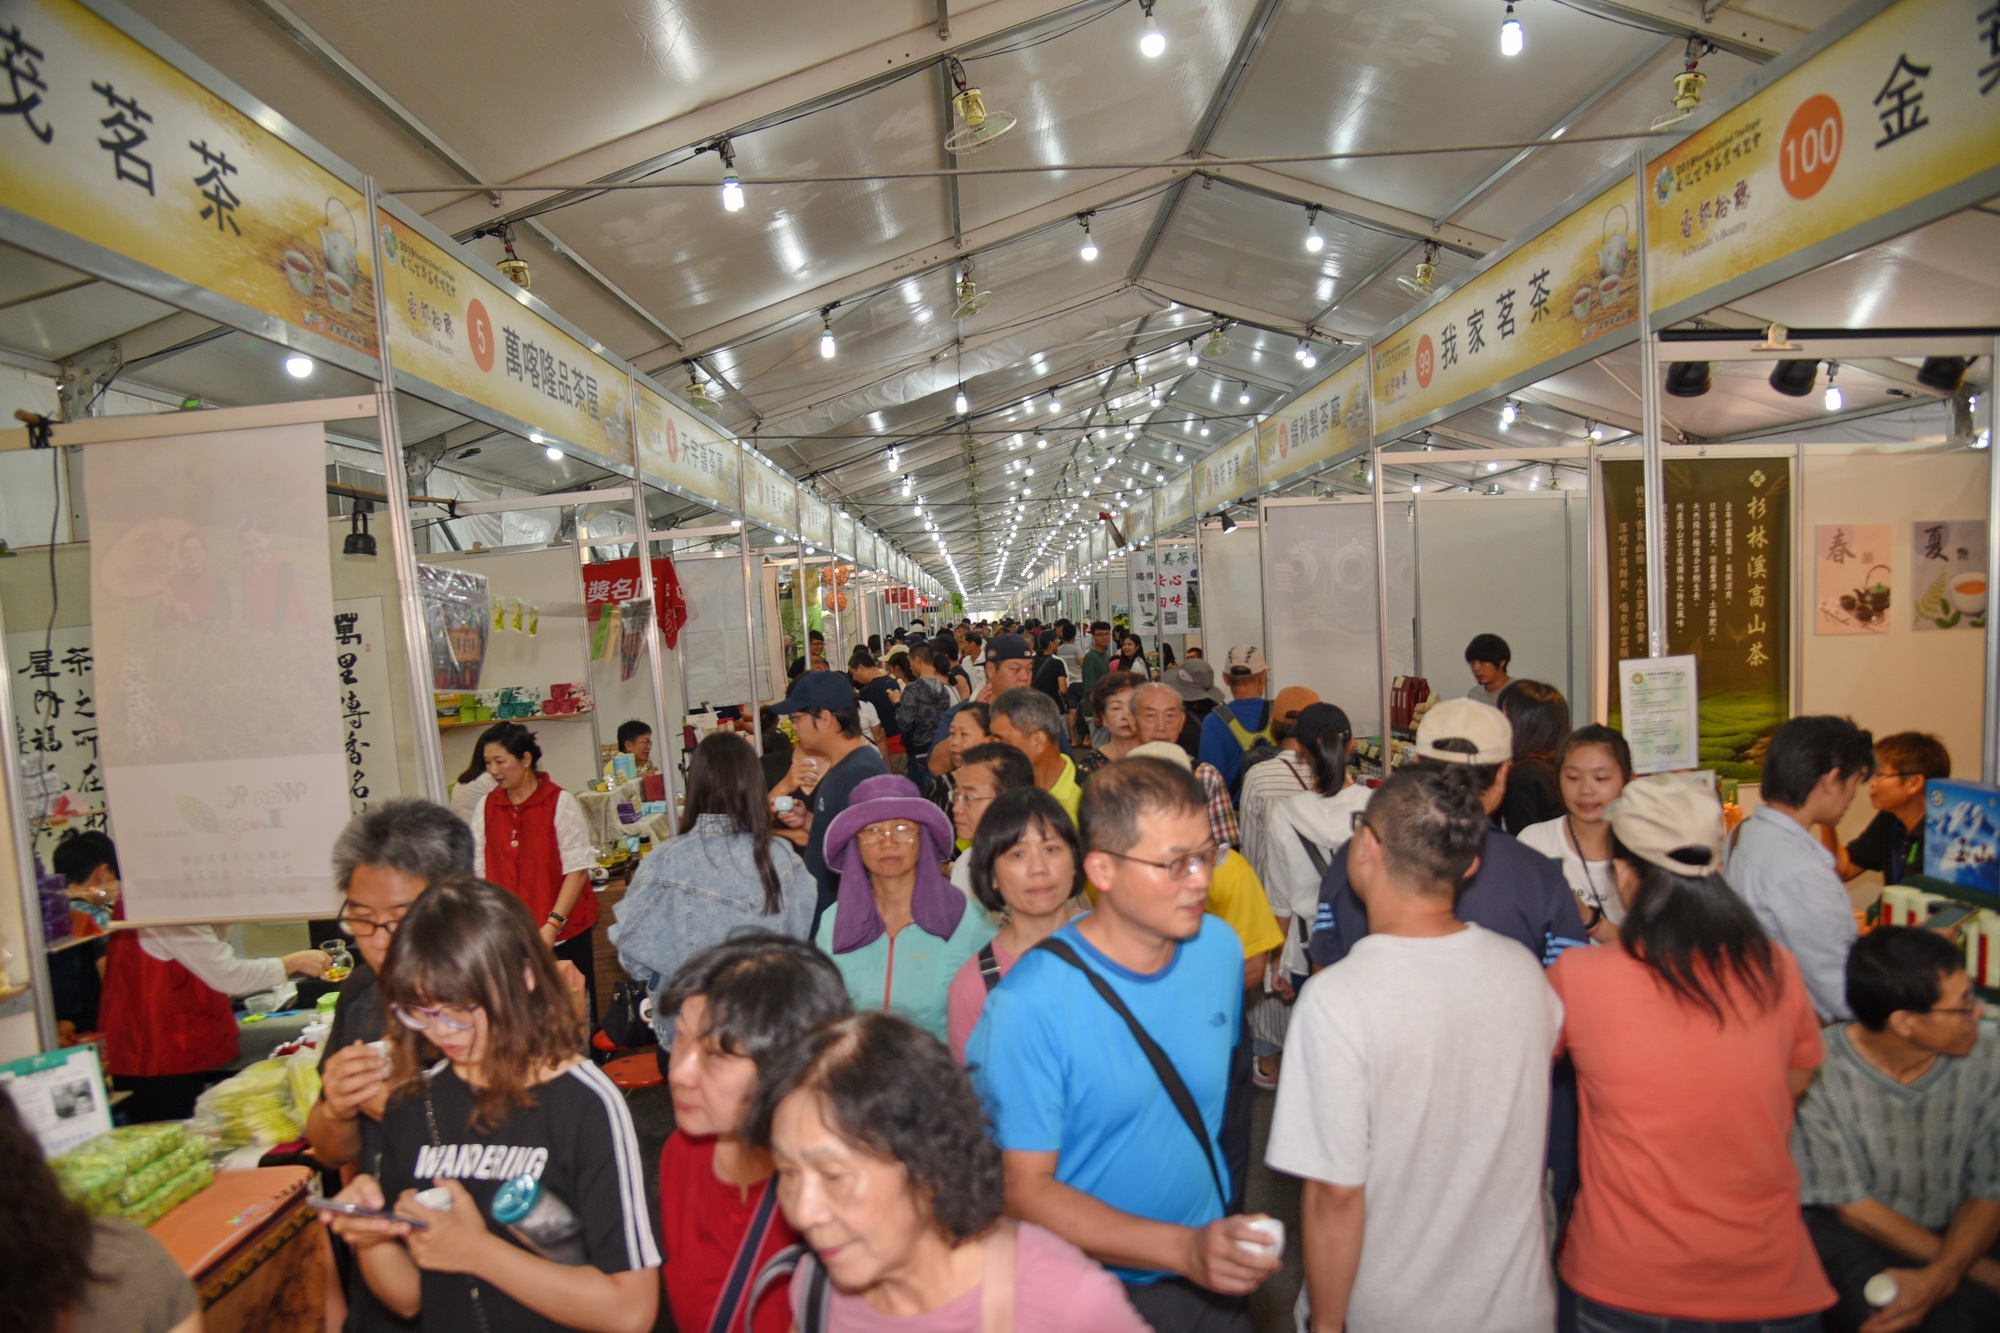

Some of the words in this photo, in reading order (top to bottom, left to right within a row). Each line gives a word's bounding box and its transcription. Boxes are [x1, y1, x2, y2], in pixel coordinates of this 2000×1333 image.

[1675, 155, 1696, 176] 2019
[1786, 116, 1839, 182] 100
[476, 319, 487, 355] 5
[1440, 267, 1551, 371] 我家茗茶
[1419, 349, 1430, 376] 99
[1826, 528, 1857, 565] 春
[1923, 525, 1949, 562] 夏
[1746, 495, 1770, 668] 杉林溪高山茶
[413, 1143, 549, 1181] WANDERING
